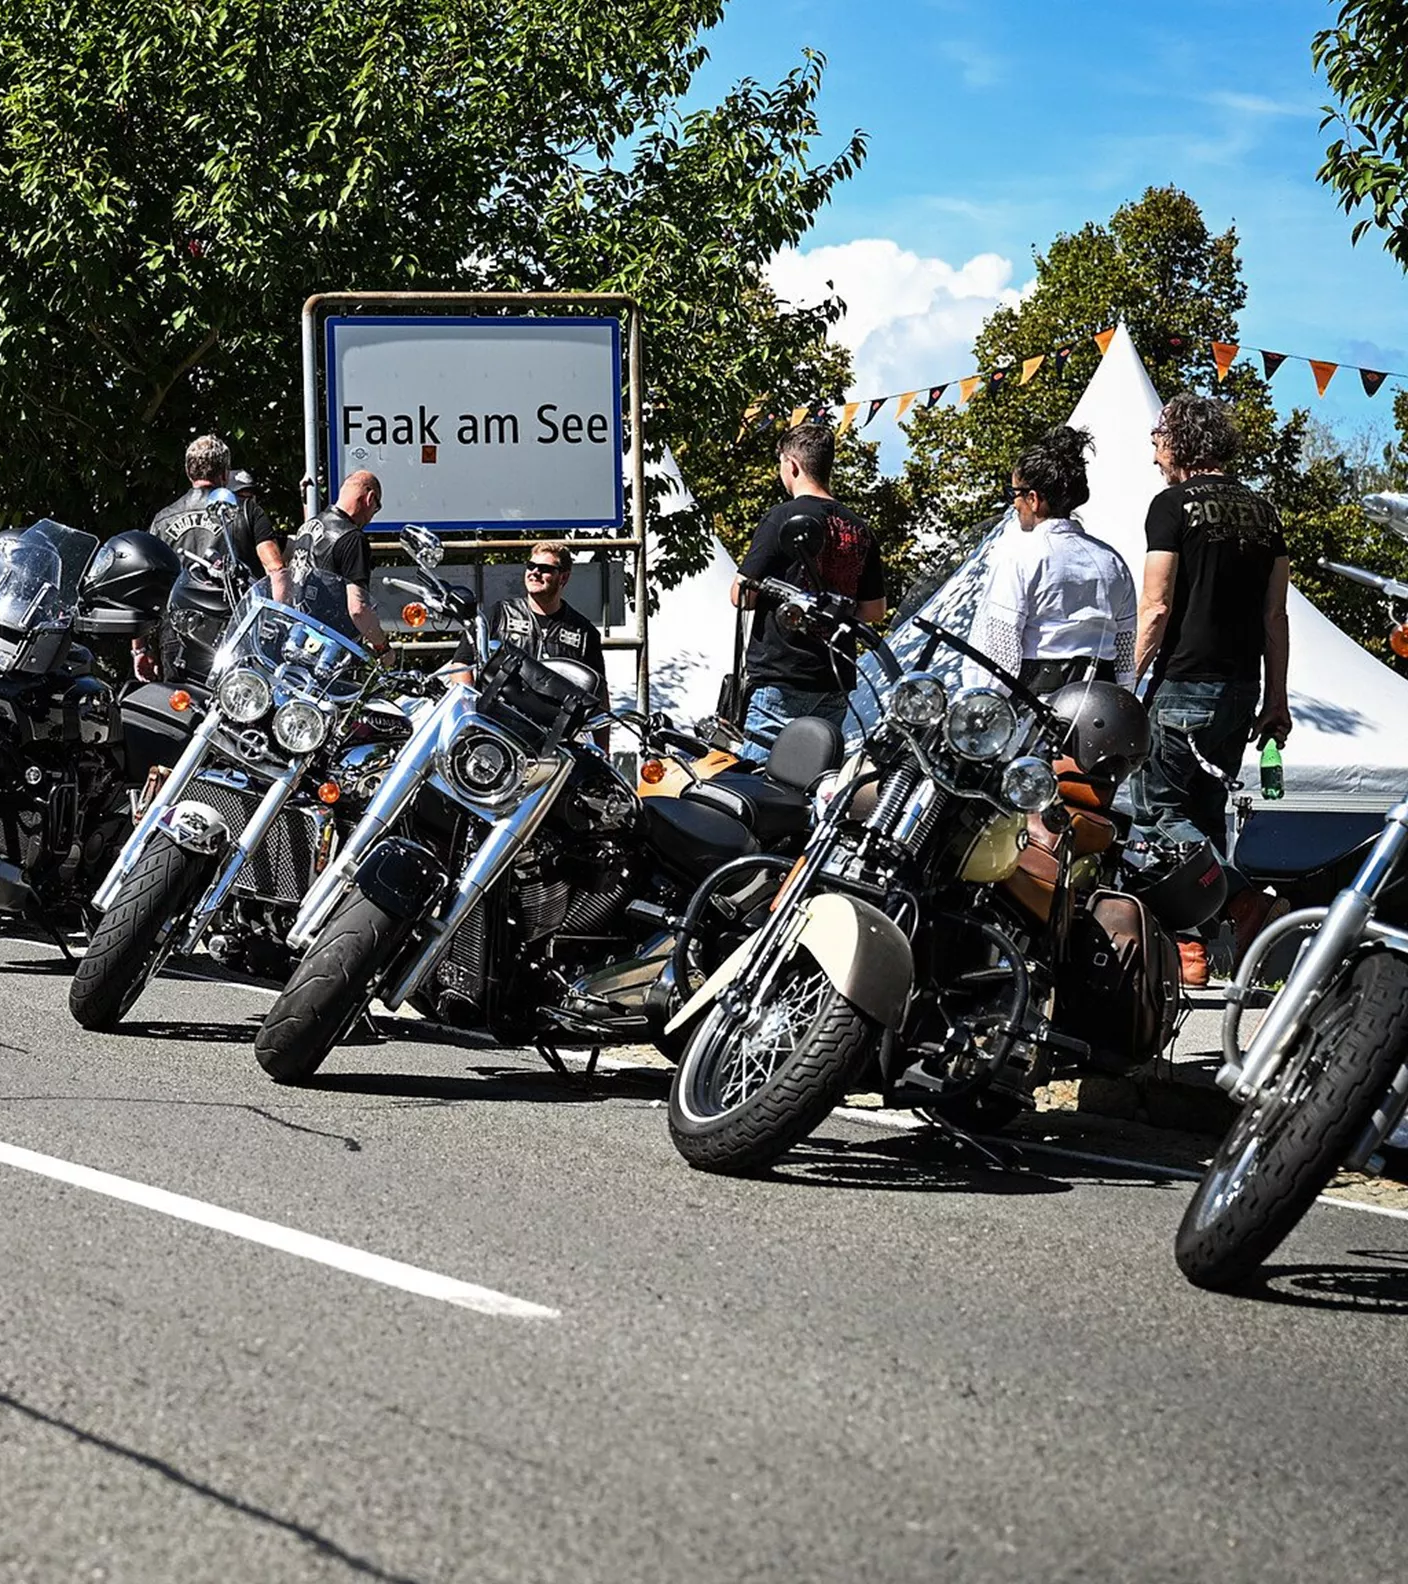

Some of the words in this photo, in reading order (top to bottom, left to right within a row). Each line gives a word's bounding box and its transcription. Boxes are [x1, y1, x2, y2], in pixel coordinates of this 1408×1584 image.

[343, 405, 441, 446] Faak
[457, 414, 519, 444] am
[537, 403, 608, 444] See
